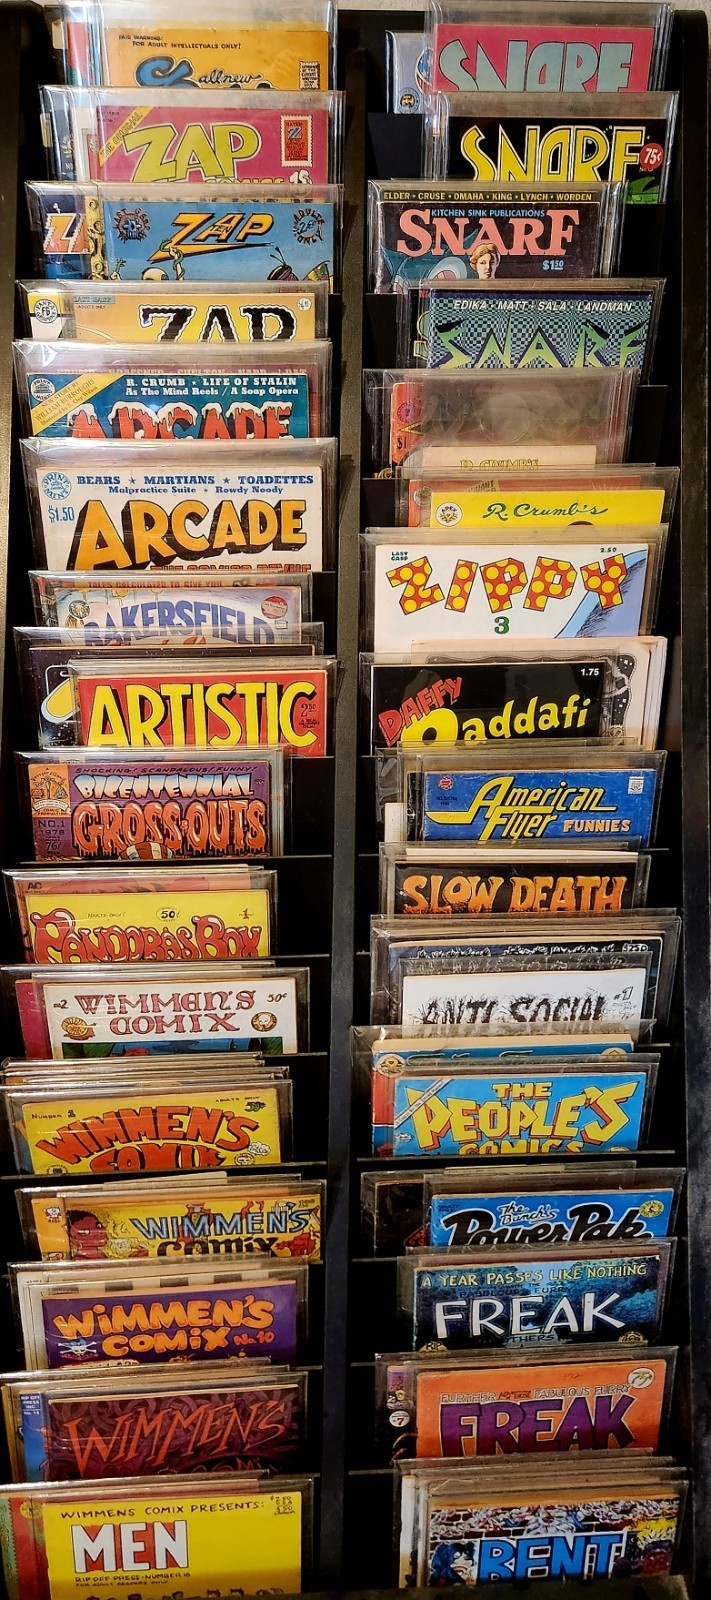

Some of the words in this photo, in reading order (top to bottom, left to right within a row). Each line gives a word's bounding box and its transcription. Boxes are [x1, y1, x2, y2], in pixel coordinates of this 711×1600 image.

[122, 122, 262, 183] ZAP
[383, 192, 411, 200] ELDER
[418, 192, 446, 200] CRUSE
[453, 192, 484, 200] OMAHA
[492, 193, 512, 201] KING
[520, 193, 548, 201] LYNCH
[556, 193, 592, 201] WORDEN
[431, 209, 465, 217] KITCHEN
[468, 209, 487, 217] SINK
[489, 209, 545, 217] PUBLICATIONS
[147, 212, 274, 262] ZAP
[397, 208, 580, 257] SNARF
[453, 300, 487, 310] EDIKA
[497, 300, 528, 310] MATT
[537, 301, 567, 311] SALA
[577, 301, 633, 311] LANDMAN
[125, 387, 138, 396] As
[140, 387, 160, 396] The
[162, 387, 189, 396] Mind
[192, 387, 219, 396] Reels
[231, 387, 238, 396] A
[241, 387, 266, 397] Soap
[269, 386, 299, 397] Opera
[126, 378, 138, 387] R.
[141, 378, 186, 387] CRUMB
[202, 377, 230, 386] LIFE
[234, 377, 250, 386] OF
[253, 377, 297, 386] STALIN
[77, 475, 121, 485] BEARS
[144, 475, 215, 485] MARTIANS
[238, 475, 314, 485] TOADETTES
[108, 486, 168, 495] Malpractice
[171, 486, 196, 494] Suite
[215, 485, 249, 495] Rowdy
[252, 485, 284, 495] Noody
[48, 505, 75, 523] $1.50
[482, 502, 508, 521] R.
[513, 502, 608, 517] Crumb's
[66, 499, 307, 571] ARCADE
[385, 553, 627, 615] ZIPPY
[494, 616, 510, 634] 3
[580, 668, 600, 676] 1.75
[87, 681, 318, 748] ARTISTIC
[378, 676, 462, 748] DAFFY
[73, 773, 255, 799] BICENTENNIAL
[424, 776, 618, 824] American
[71, 799, 268, 856] GROSS-OUTS
[478, 805, 558, 844] Flyer
[563, 819, 631, 833] FUNNIES
[402, 875, 504, 914] SLOW
[509, 875, 628, 913] DEATH
[109, 1012, 240, 1036] COMIX
[491, 1081, 553, 1100] THE
[405, 1081, 640, 1151] PEOPLE'S
[35, 1105, 260, 1165] WIMMEN'S
[497, 1201, 529, 1214] The
[500, 1203, 560, 1226] Bunch's
[422, 1277, 431, 1287] A
[439, 1274, 478, 1287] YEAR
[486, 1270, 543, 1285] PASSES
[549, 1266, 582, 1280] LIKE
[587, 1264, 648, 1278] NOTHING
[435, 1292, 626, 1339] FREAK
[440, 1392, 497, 1404] FURTHER
[533, 1386, 590, 1399] FABULOUS
[440, 1393, 636, 1457] FREAK
[63, 1400, 286, 1478] WIMMEN'S
[60, 1508, 136, 1519] WIMMENS
[145, 1506, 184, 1514] COMIX
[190, 1501, 264, 1513] PRESENTS:
[71, 1519, 189, 1573] MEN
[480, 1535, 622, 1582] BENT
